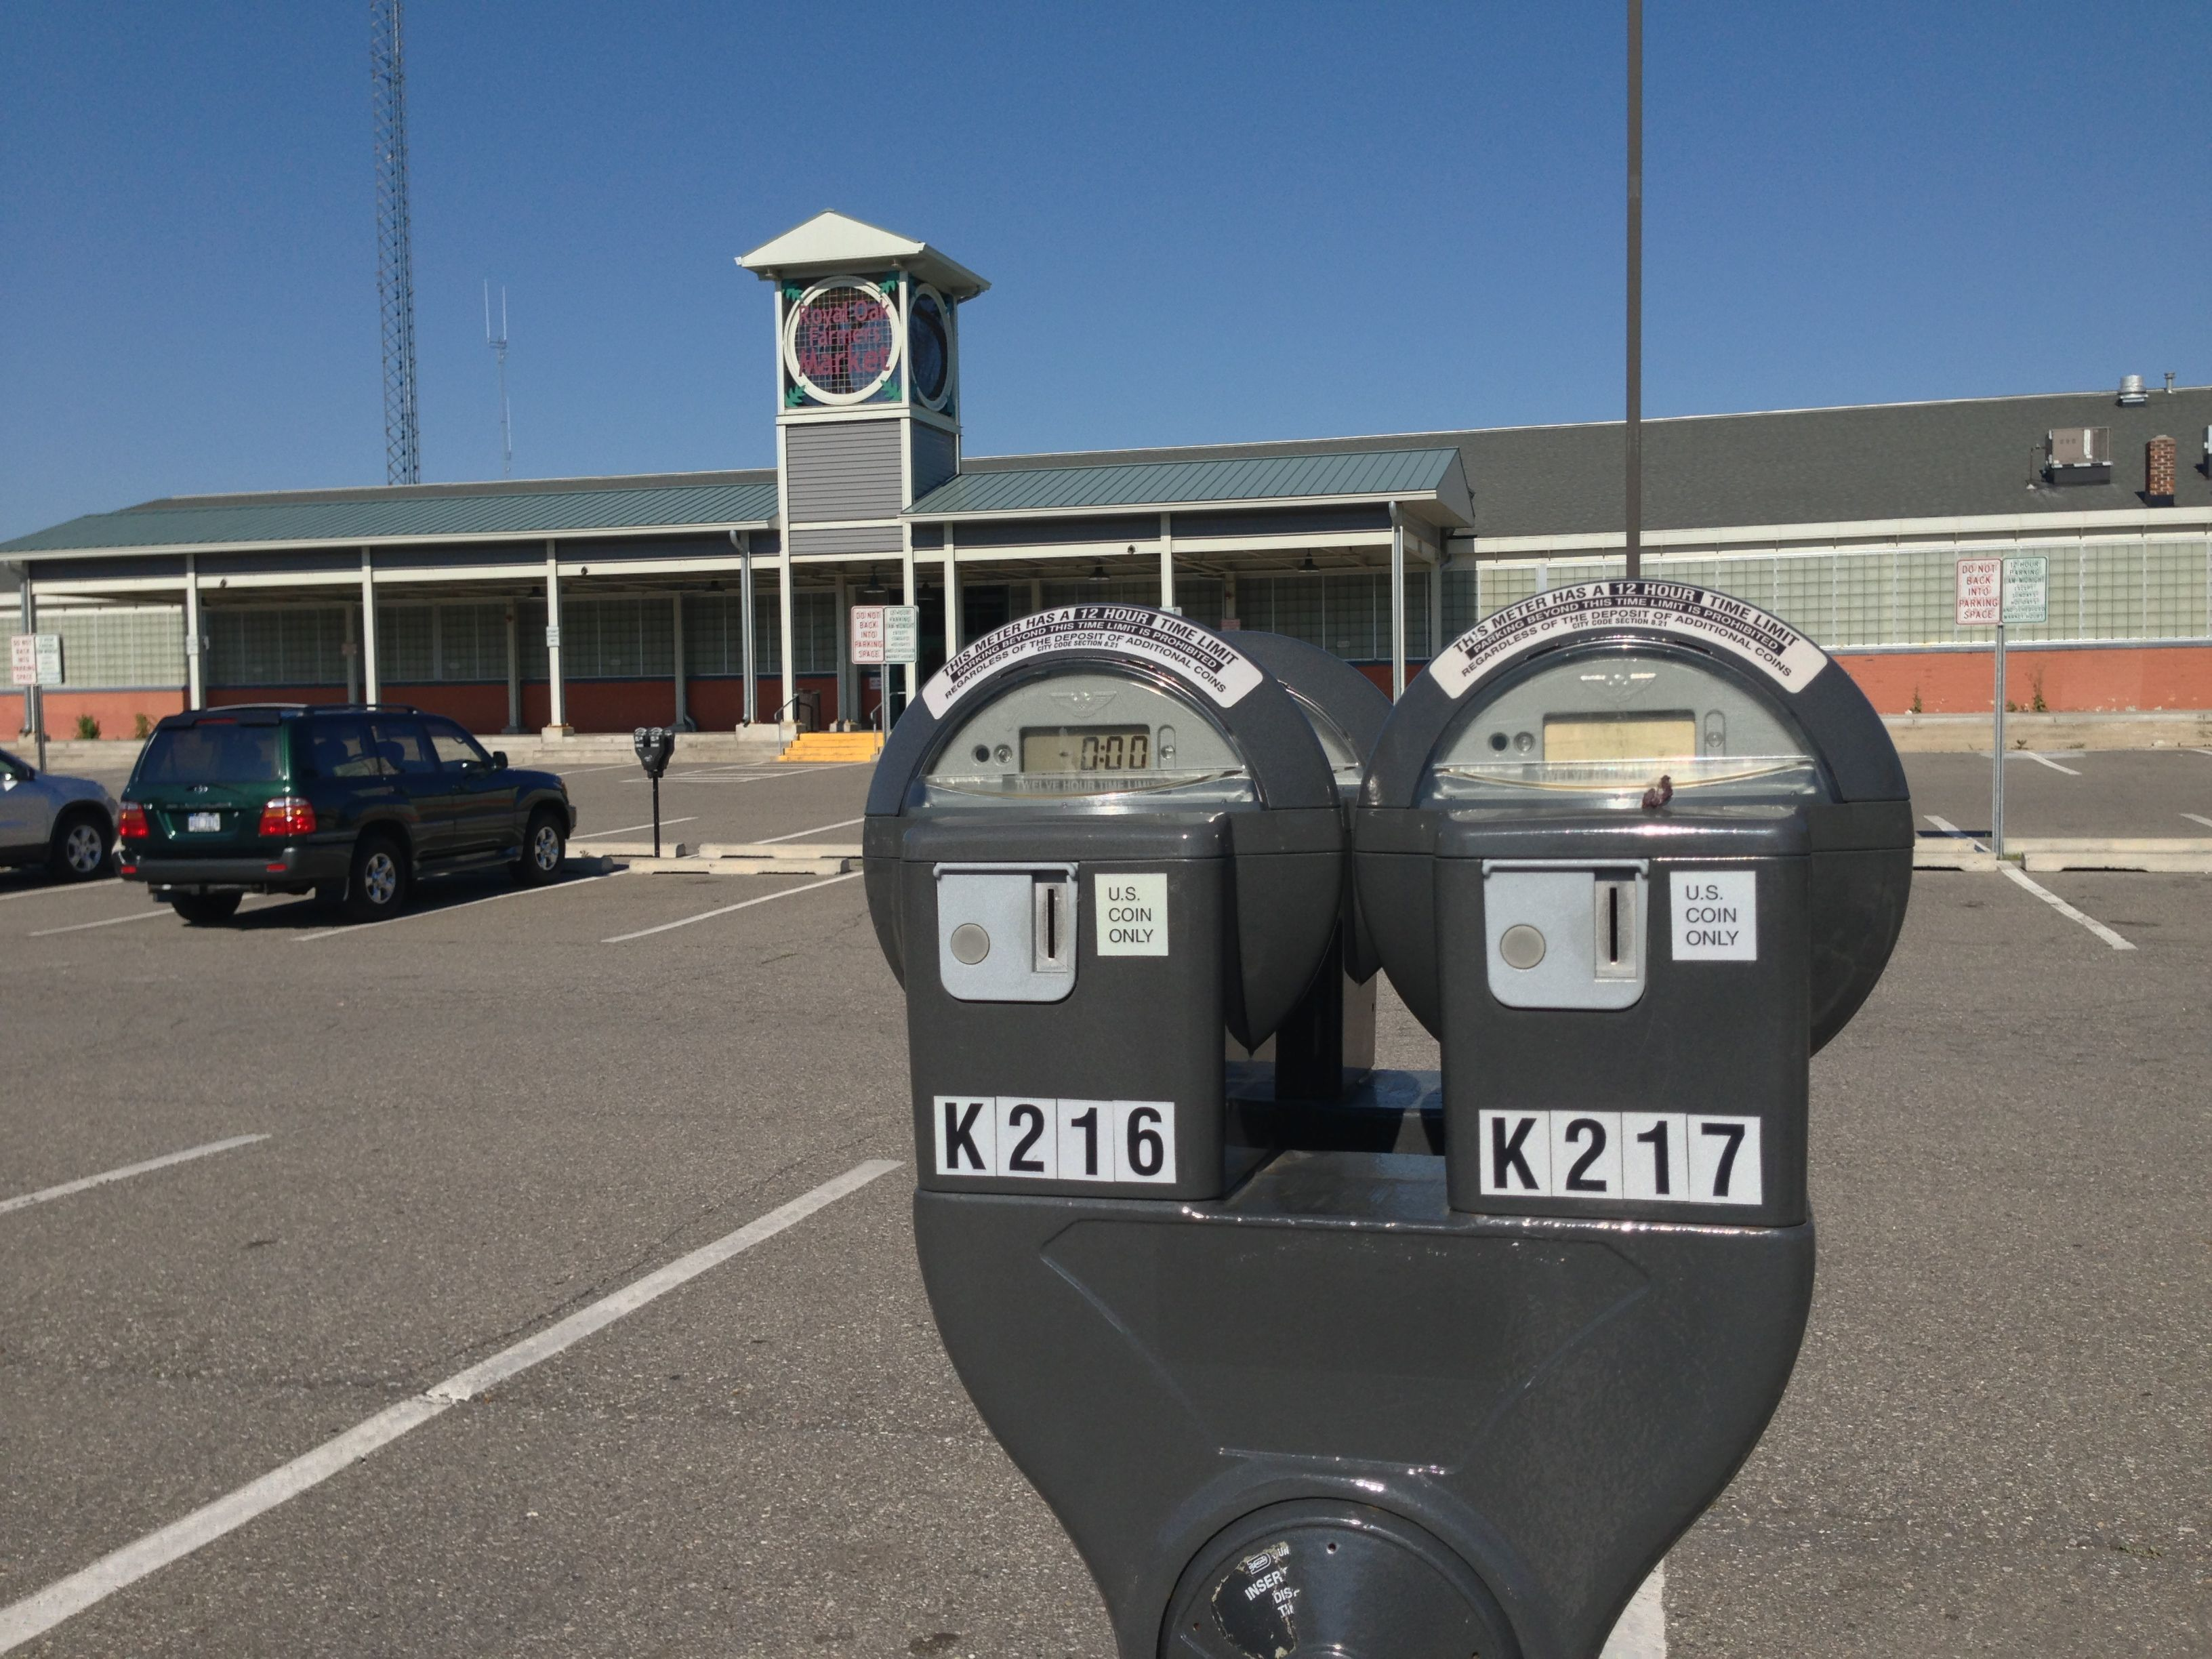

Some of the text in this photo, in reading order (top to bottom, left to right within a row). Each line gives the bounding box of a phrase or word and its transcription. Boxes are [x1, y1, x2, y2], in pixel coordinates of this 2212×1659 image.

[799, 301, 847, 326] Royal
[808, 327, 880, 346] Farmers
[799, 346, 890, 377] Market
[1962, 565, 1995, 574] DO NOT
[1967, 577, 1991, 586] BACK
[1968, 588, 1989, 596] INTO
[1959, 598, 1998, 607] PARKING
[1453, 583, 1799, 653] THIS METER HAS A 12 HOUR TIME LIMIT
[1964, 611, 1992, 619] SPACE
[1473, 622, 1524, 653] PARKING
[1527, 603, 1579, 624] BEYOND
[1582, 599, 1612, 609] THIS
[1617, 598, 1647, 606] TIME
[1650, 599, 1685, 611] LIMIT
[1687, 605, 1701, 615] IS
[1572, 621, 1589, 630] CITY
[1592, 618, 1612, 626] CODE
[942, 609, 1239, 676] THIS METER HAS A 12 HOUR TIME LIMIT
[957, 646, 1000, 676] PARKING
[1002, 628, 1046, 648] BEYOND
[1050, 623, 1074, 632] THIS
[1078, 621, 1104, 630] TIME
[1107, 623, 1137, 633] LIMIT
[1139, 628, 1150, 636] IS
[1038, 643, 1052, 652] CITY
[1054, 640, 1071, 649] CODE
[1104, 640, 1118, 649] 8.21
[1462, 610, 1793, 677] REGARDLESS OF THE DEPOSIT OF ADDITIONAL COINS
[945, 633, 1226, 699] REGARDLESS OF THE DEPOSIT OF ADDITIONAL COINS
[1109, 886, 1140, 901] U.S.
[1686, 884, 1723, 900] U.S.
[1109, 907, 1151, 922] COIN
[1686, 907, 1736, 923] COIN
[1109, 928, 1153, 943] ONLY
[1686, 930, 1739, 945] ONLY
[945, 1103, 1164, 1176] K216
[1492, 1117, 1745, 1196] K217
